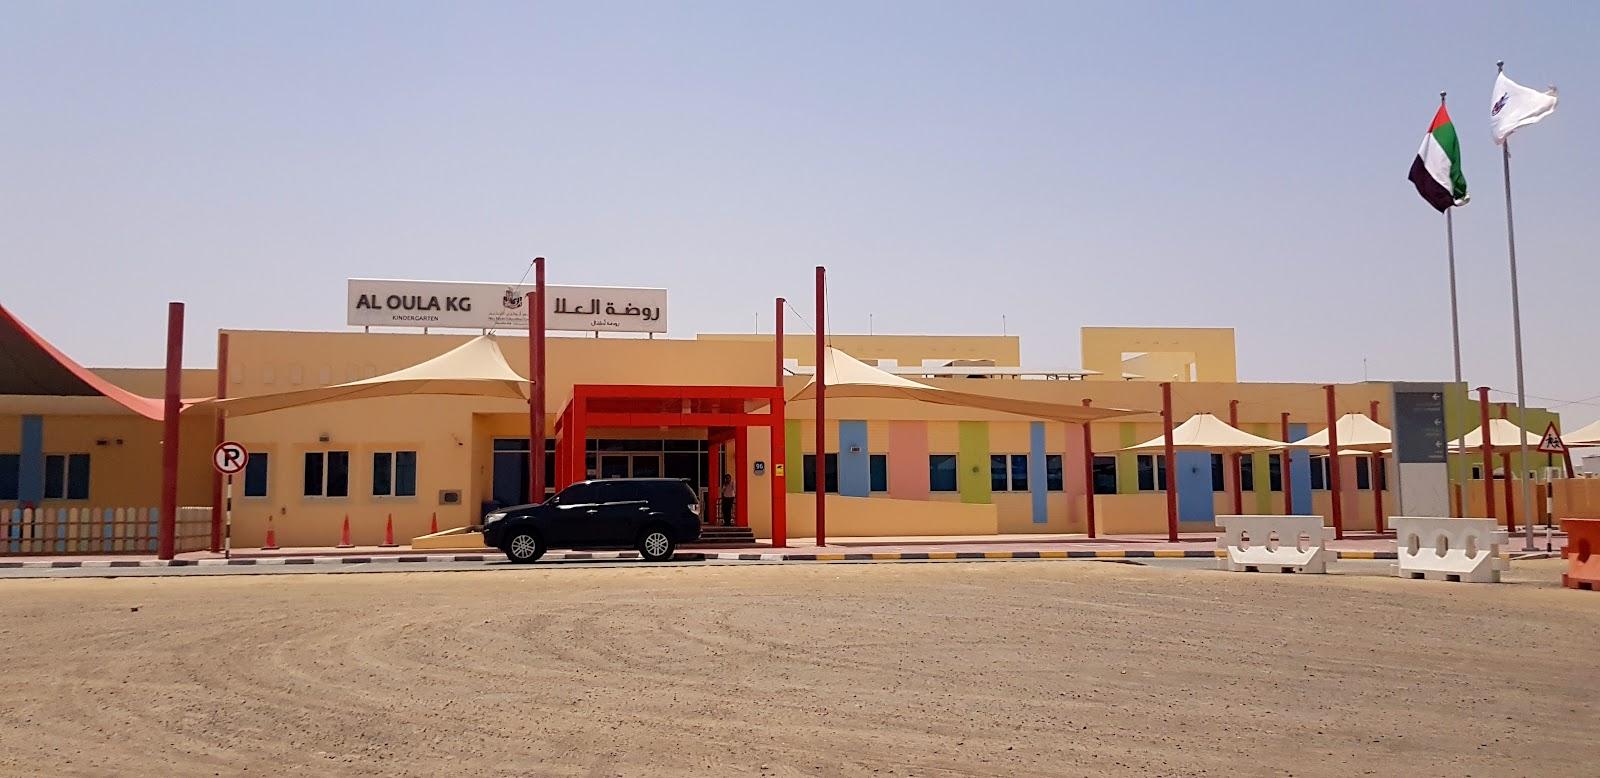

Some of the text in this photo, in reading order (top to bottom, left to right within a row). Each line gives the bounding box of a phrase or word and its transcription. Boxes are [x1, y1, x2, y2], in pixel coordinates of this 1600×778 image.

[356, 294, 472, 312] AL OULA KG
[553, 297, 660, 321] روضة العلا
[224, 448, 240, 466] P
